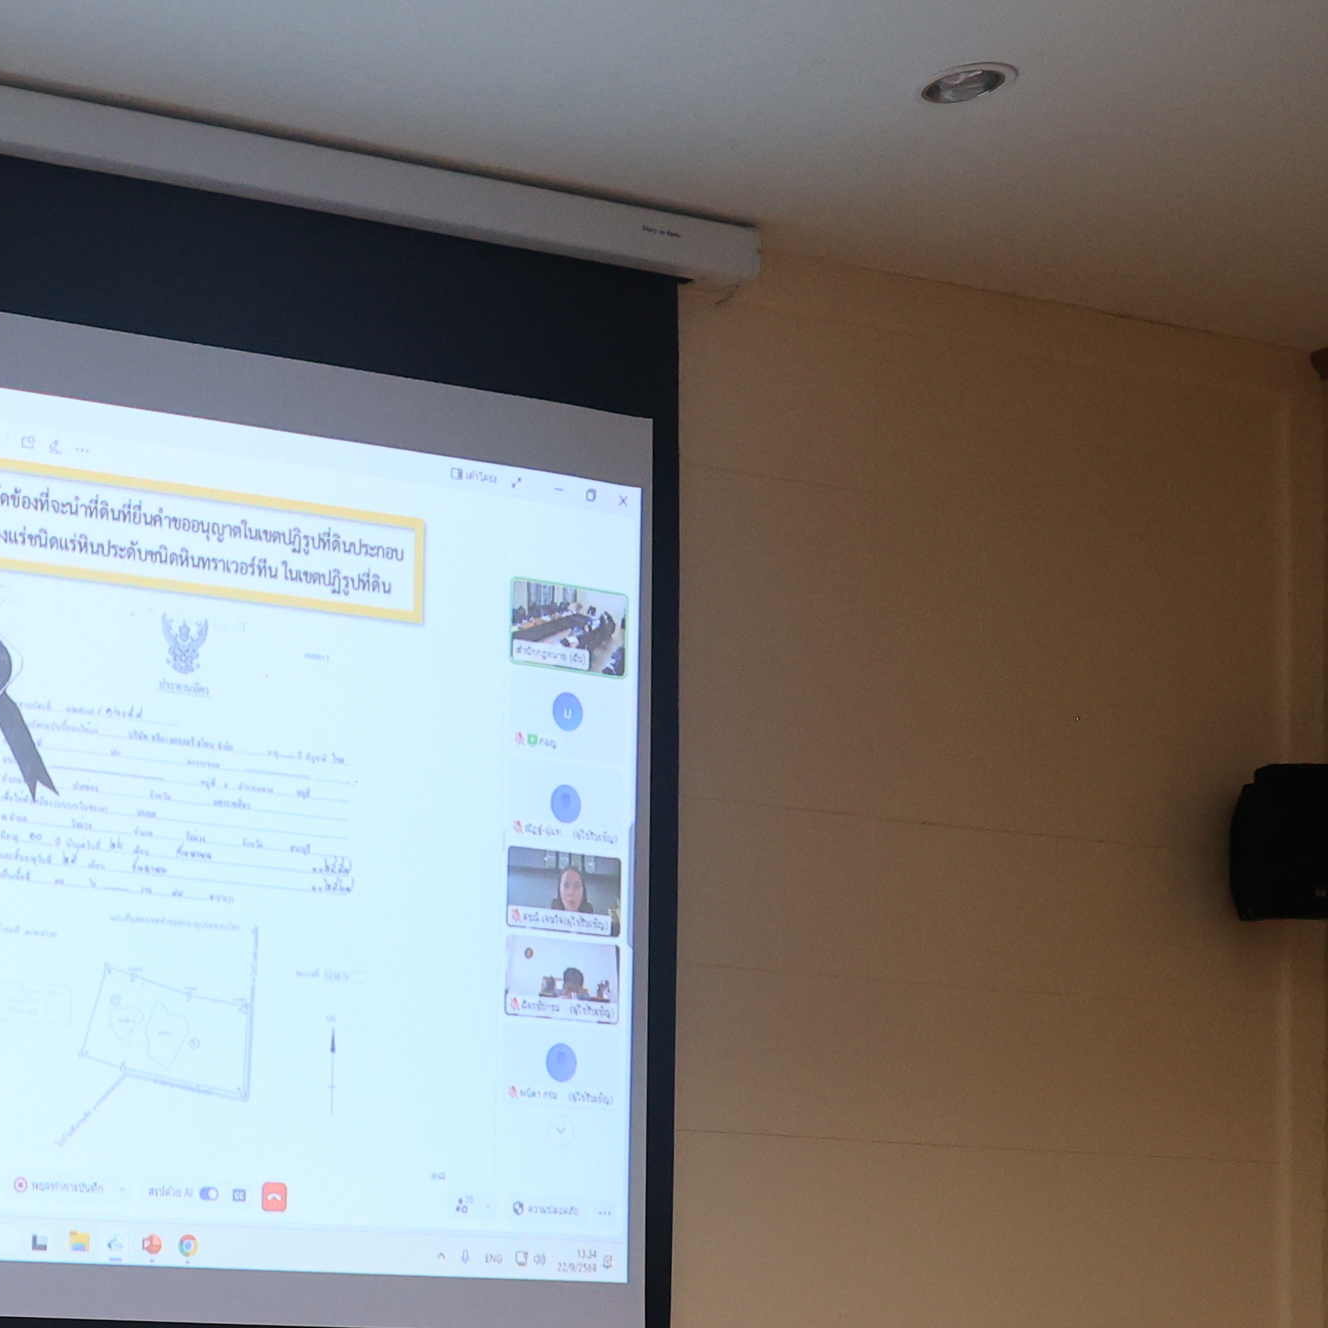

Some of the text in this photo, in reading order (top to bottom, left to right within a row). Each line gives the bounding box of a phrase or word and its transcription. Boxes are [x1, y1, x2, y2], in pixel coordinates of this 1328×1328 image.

[280, 559, 392, 597] ในเขตปฏิรูปที่ดิน
